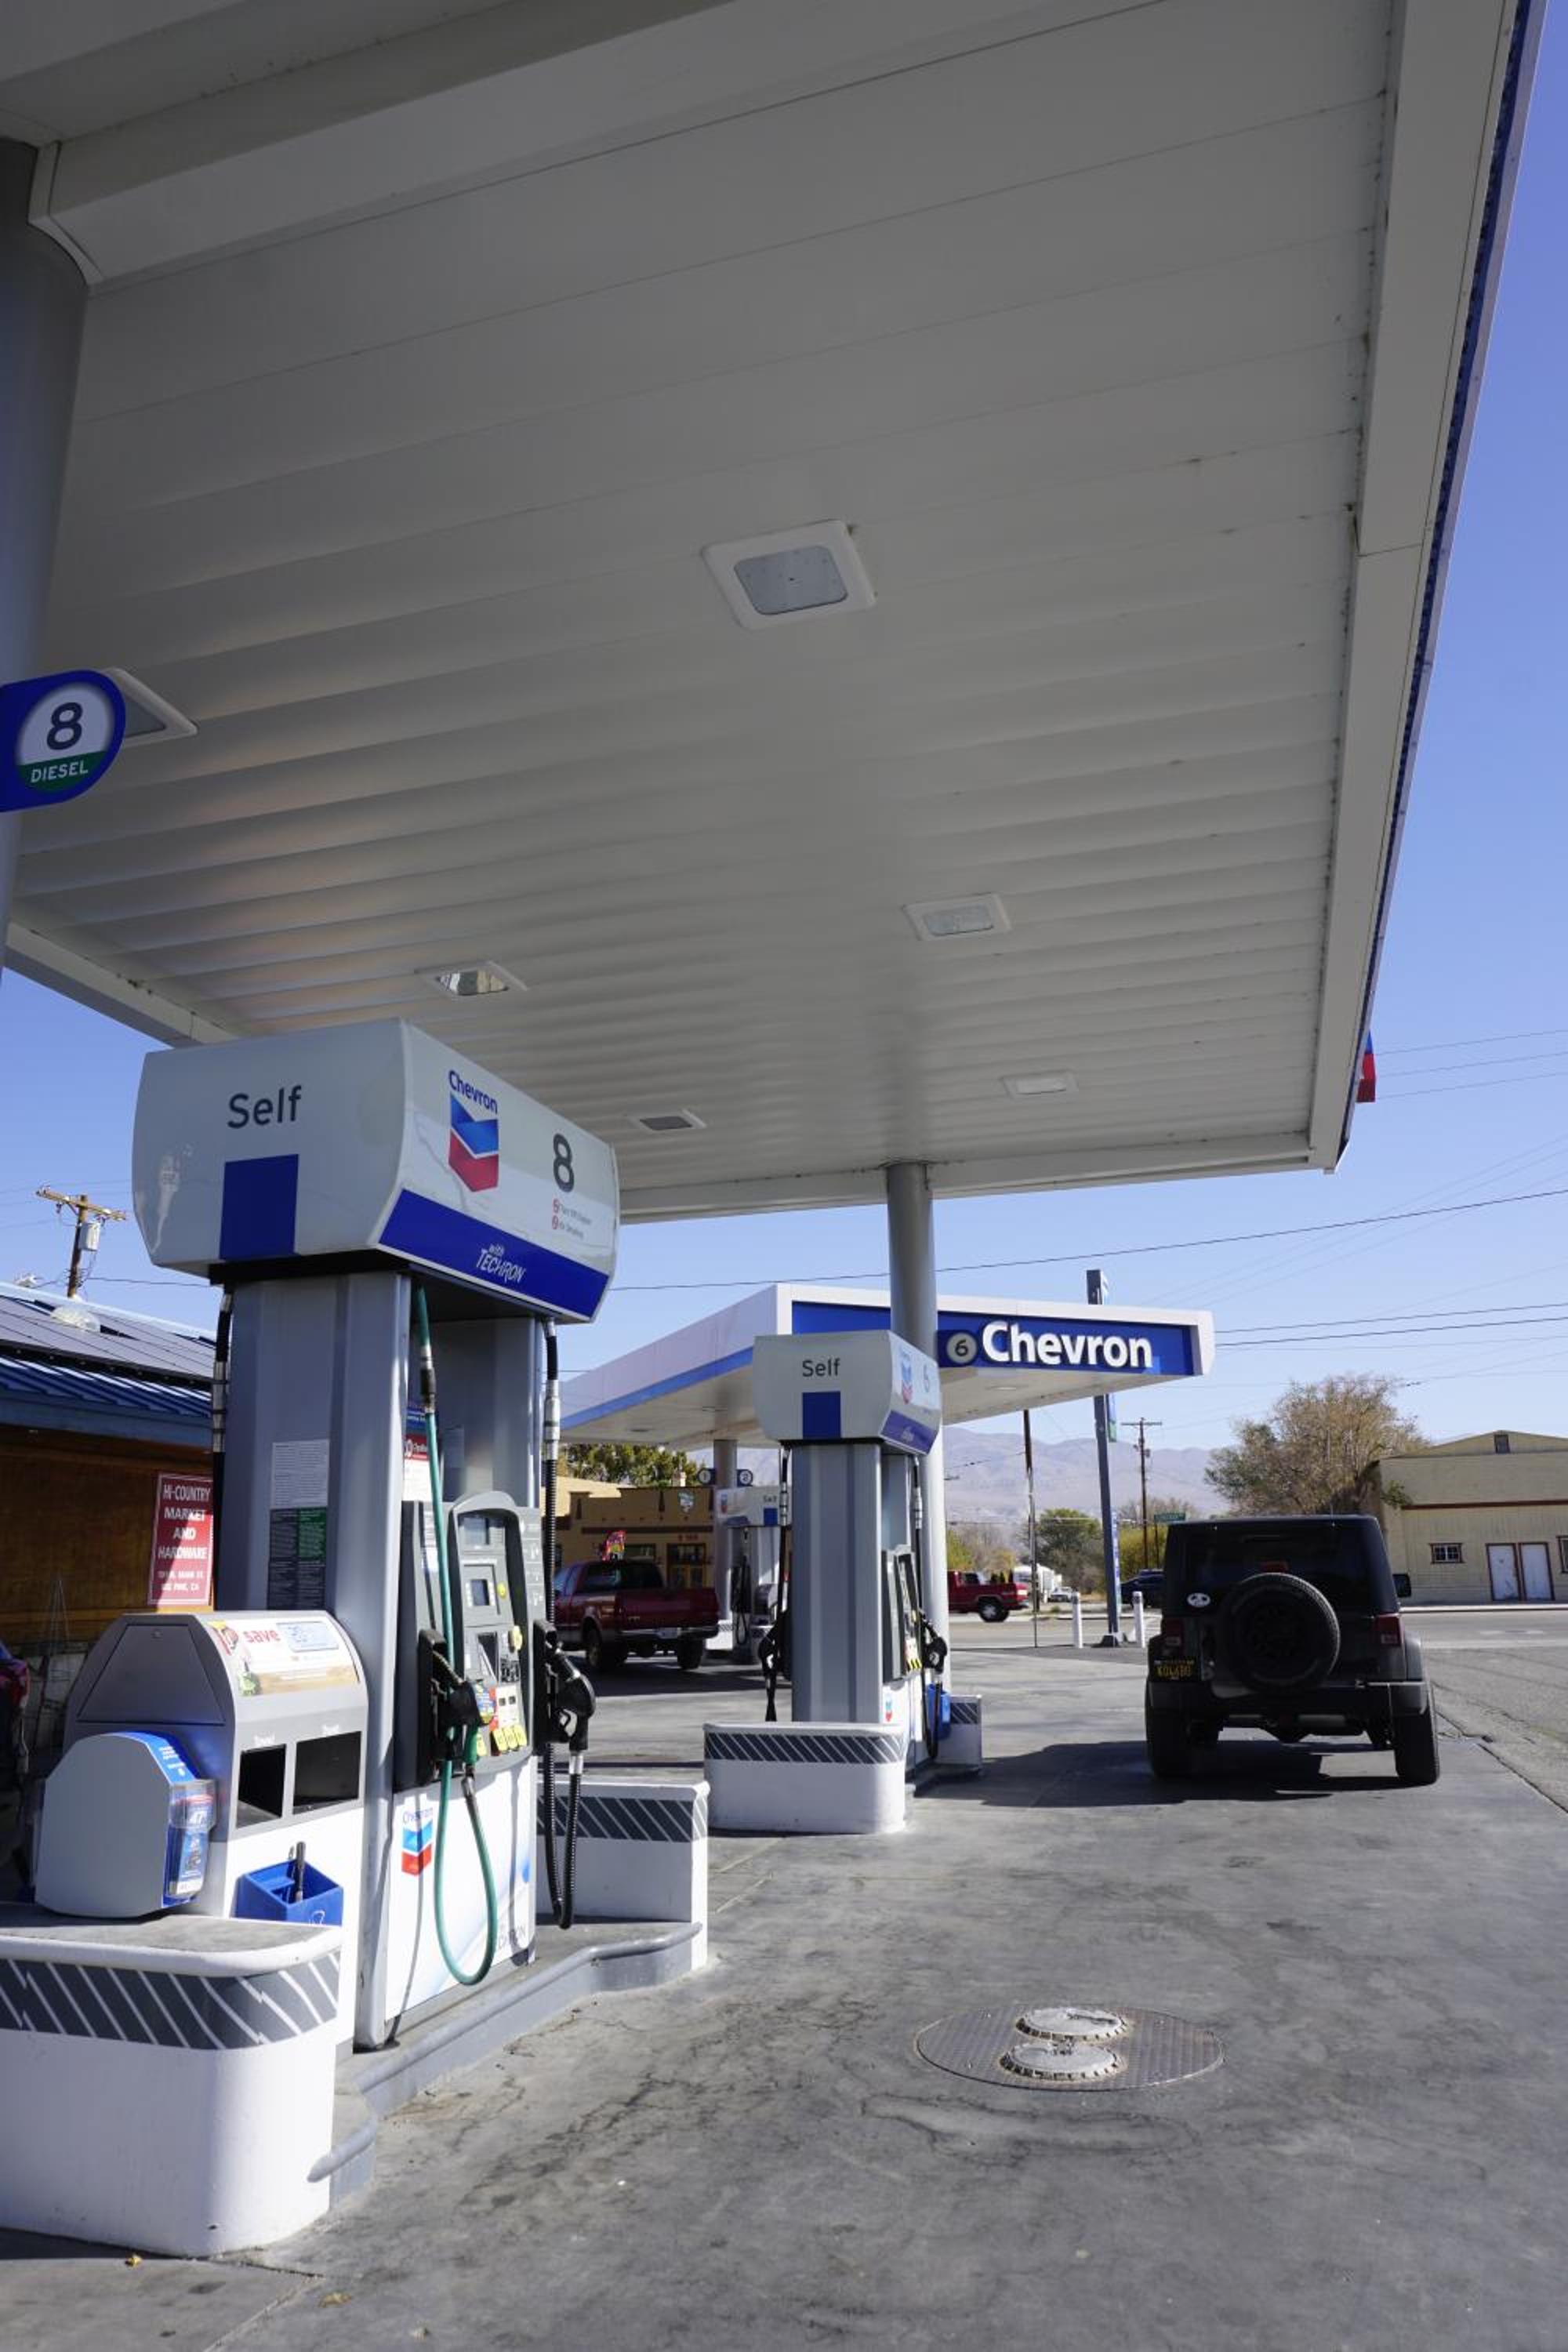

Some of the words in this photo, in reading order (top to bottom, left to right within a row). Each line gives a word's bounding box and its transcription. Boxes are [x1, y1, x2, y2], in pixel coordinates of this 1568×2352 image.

[46, 702, 83, 750] 8
[30, 760, 89, 783] DIESEL
[448, 1069, 499, 1114] Chevron
[227, 1085, 302, 1129] Self
[553, 1133, 575, 1192] 8
[476, 1249, 526, 1283] TECHRON
[954, 1339, 969, 1357] 6
[982, 1320, 1153, 1367] Chevron
[802, 1357, 840, 1377] Self
[163, 1484, 211, 1501] HI-COUNTRY
[164, 1507, 205, 1522] MARKET
[173, 1526, 197, 1541] AND
[158, 1545, 208, 1560] HARDWARE
[243, 1630, 281, 1643] save
